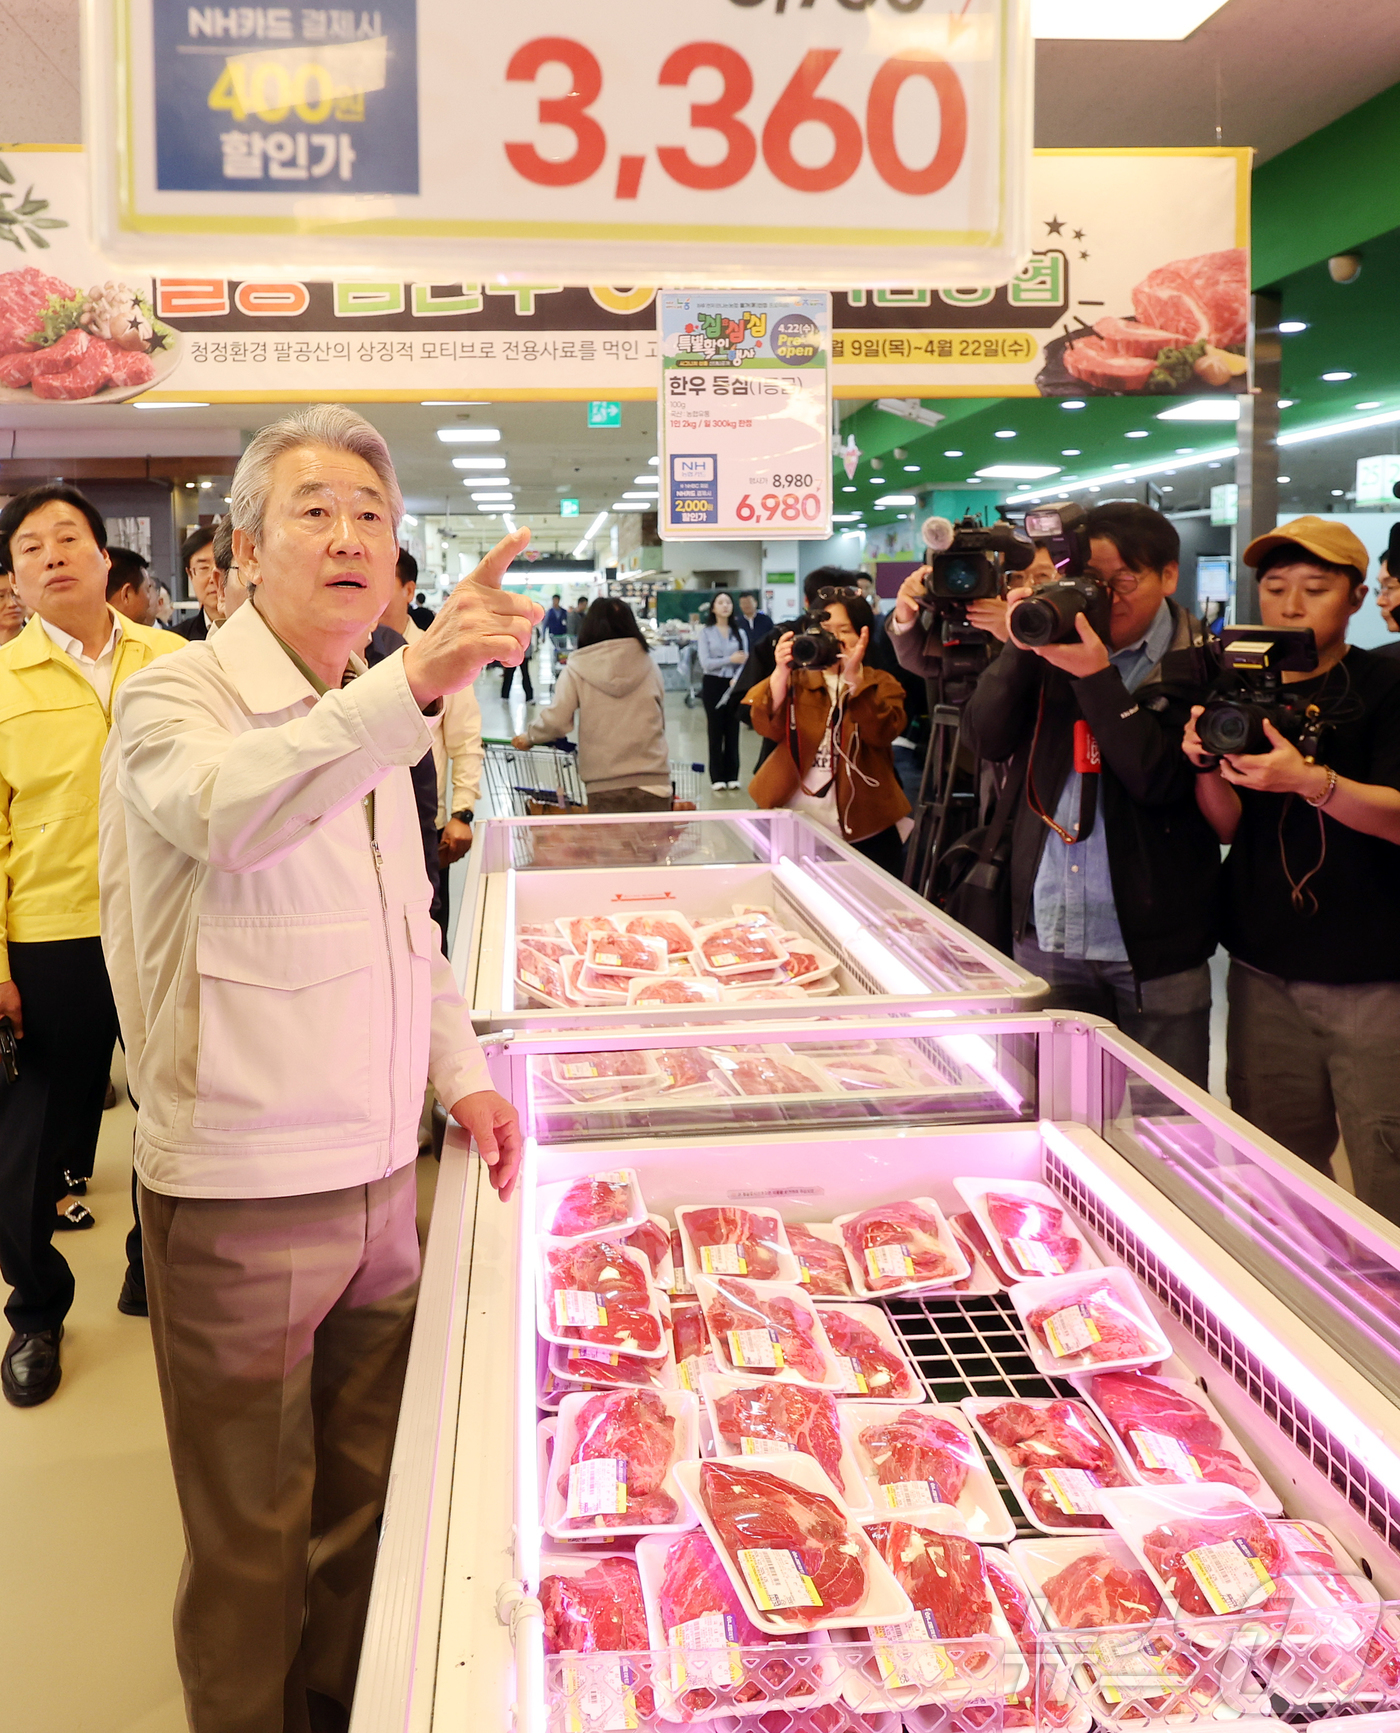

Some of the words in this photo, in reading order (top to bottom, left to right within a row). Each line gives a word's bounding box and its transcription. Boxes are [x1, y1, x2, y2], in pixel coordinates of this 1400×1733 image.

[188, 7, 293, 39] NH카드
[302, 8, 382, 40] 결제시
[207, 61, 366, 124] 400원
[504, 36, 968, 200] 3,360
[220, 130, 357, 181] 할인가
[191, 341, 267, 362] 청정환경
[274, 341, 350, 362] 팔공산의
[358, 341, 413, 362] 상징적
[420, 341, 496, 361] 모티브로
[503, 340, 597, 361] 전용사료를
[603, 340, 639, 361] 먹인
[777, 346, 813, 358] open
[851, 339, 952, 358] 9일(목)~4월
[960, 338, 1031, 357] 22일(수)
[670, 376, 706, 396] 한우
[682, 462, 706, 470] NH
[773, 474, 813, 488] 8,980
[736, 493, 821, 523] 6,980
